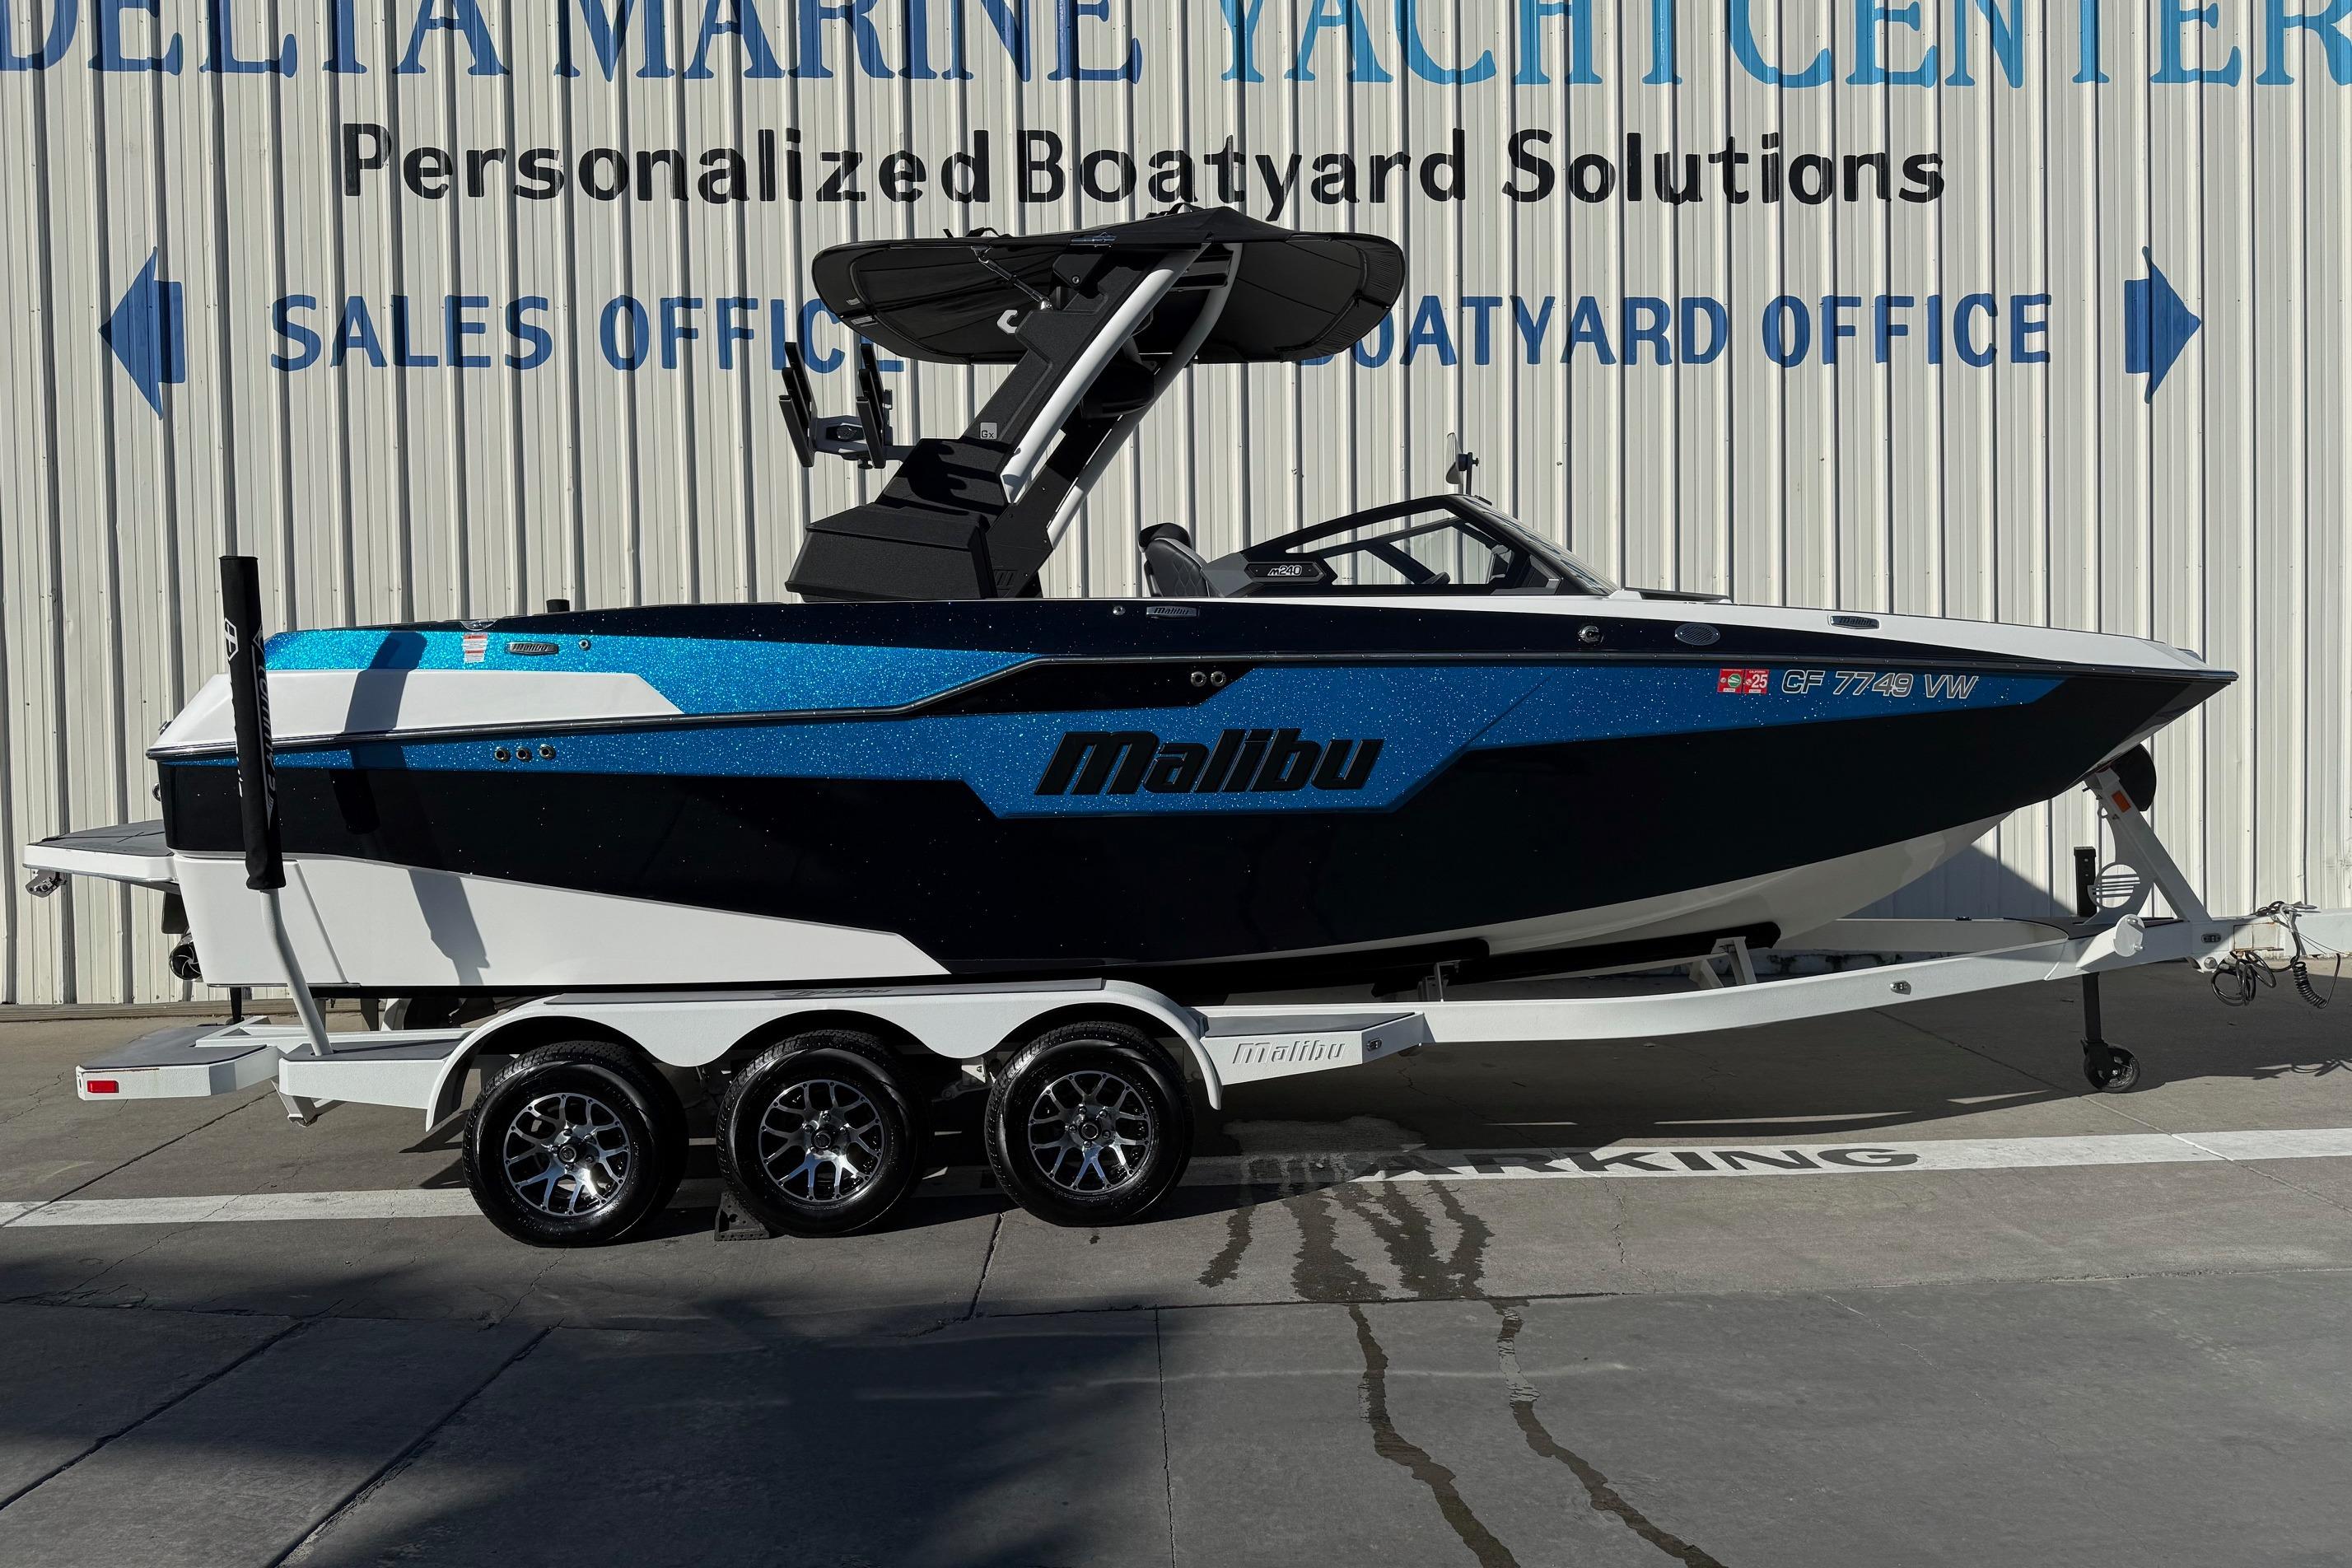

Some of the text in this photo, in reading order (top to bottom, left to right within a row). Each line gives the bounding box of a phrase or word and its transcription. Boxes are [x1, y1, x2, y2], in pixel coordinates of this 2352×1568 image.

[553, 0, 1143, 84] MARINE
[342, 123, 1946, 222] Personalized Boatyard Solutions
[271, 294, 553, 371] SALES
[1295, 292, 2052, 368] OATYARD OFFICE
[1751, 674, 1768, 688] 25
[1781, 670, 1978, 699] CF 7749 VW
[1034, 727, 1384, 796] Malibu
[1232, 1039, 1346, 1065] Malibu
[1297, 1148, 1921, 1177] ARKING
